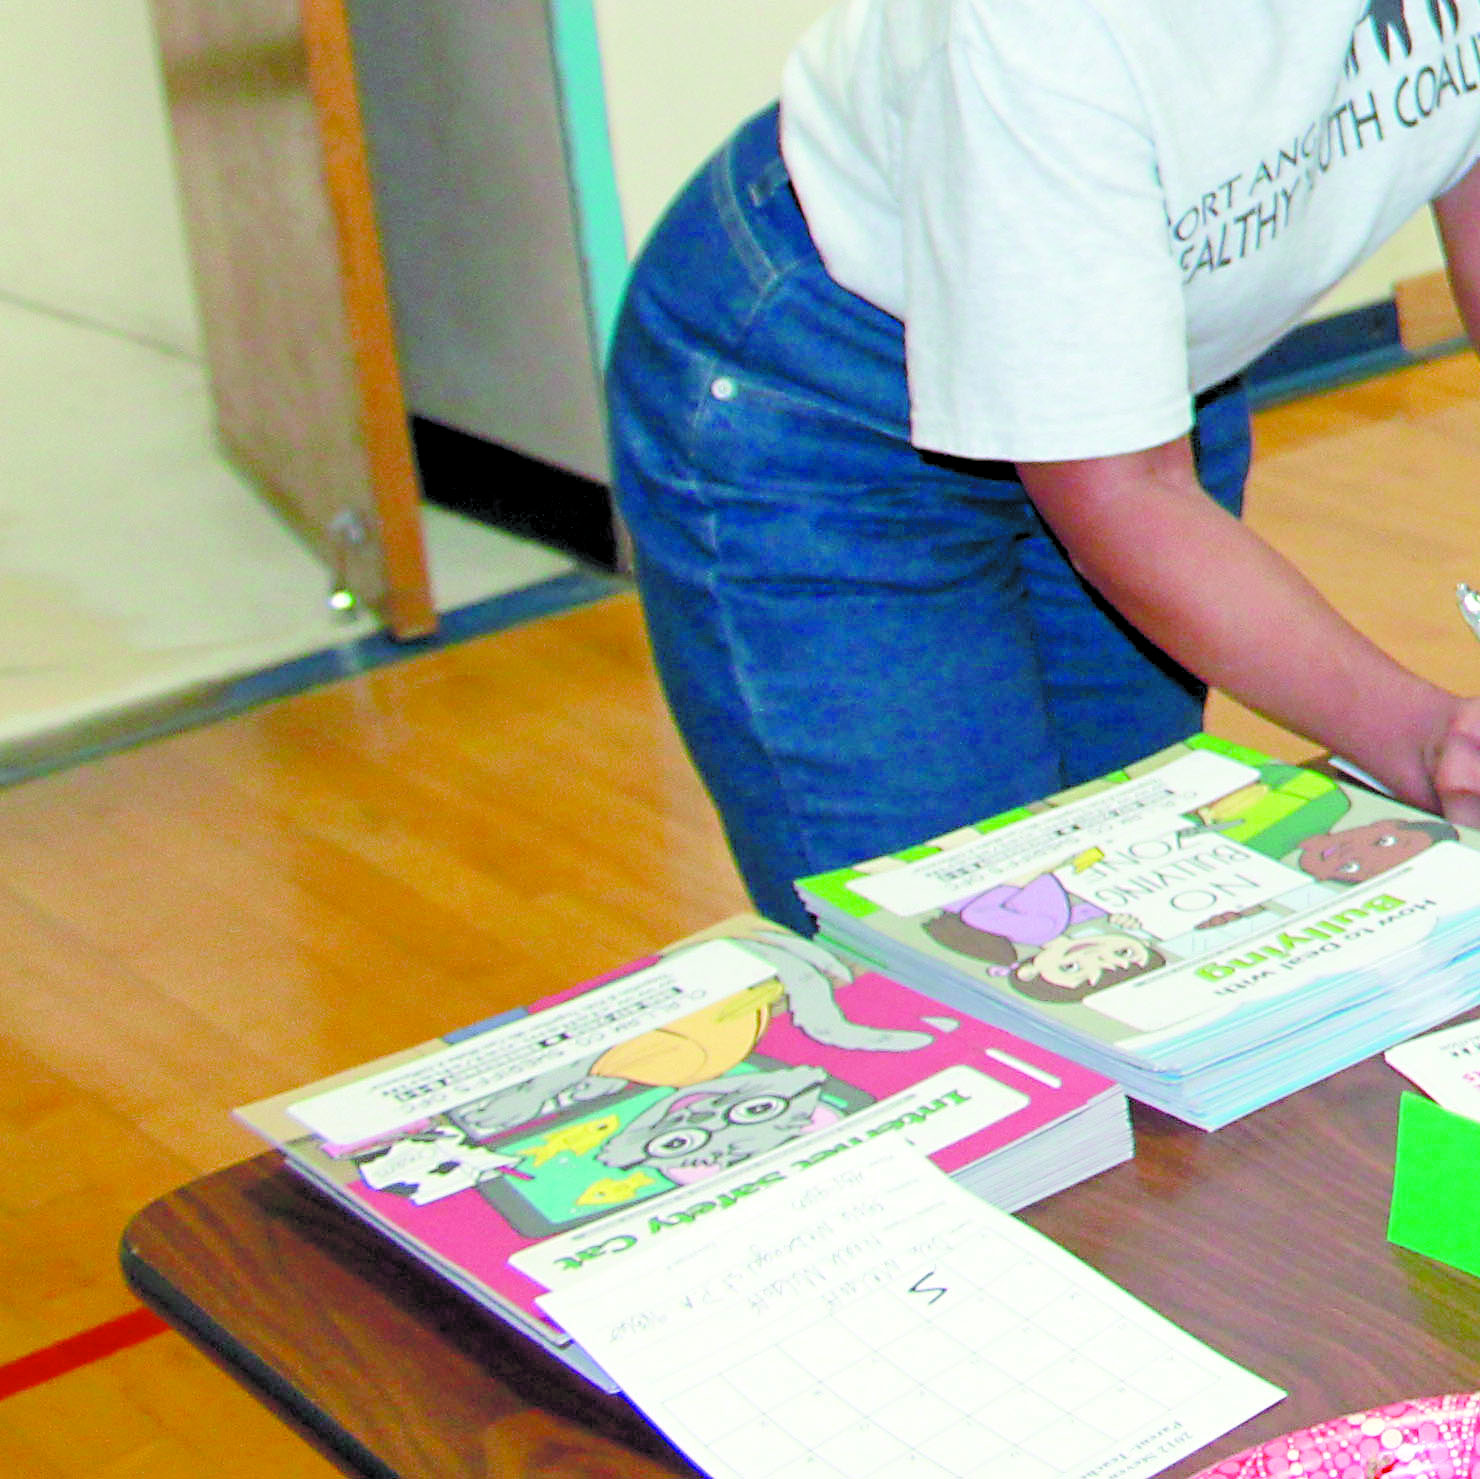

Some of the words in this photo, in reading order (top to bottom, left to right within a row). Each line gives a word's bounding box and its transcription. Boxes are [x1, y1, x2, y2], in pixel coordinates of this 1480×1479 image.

[1168, 172, 1242, 242] ORT
[1179, 176, 1301, 286] EALTHY
[1317, 90, 1384, 174] UTH
[1094, 840, 1251, 909] BULLYING
[1168, 874, 1261, 913] NO
[1378, 898, 1437, 927] How
[1193, 893, 1407, 984] Bullying
[1343, 927, 1375, 944] to
[1280, 942, 1342, 973] Deal
[1212, 970, 1277, 998] with
[790, 1088, 973, 1172] Internet
[552, 1234, 638, 1273] Cat
